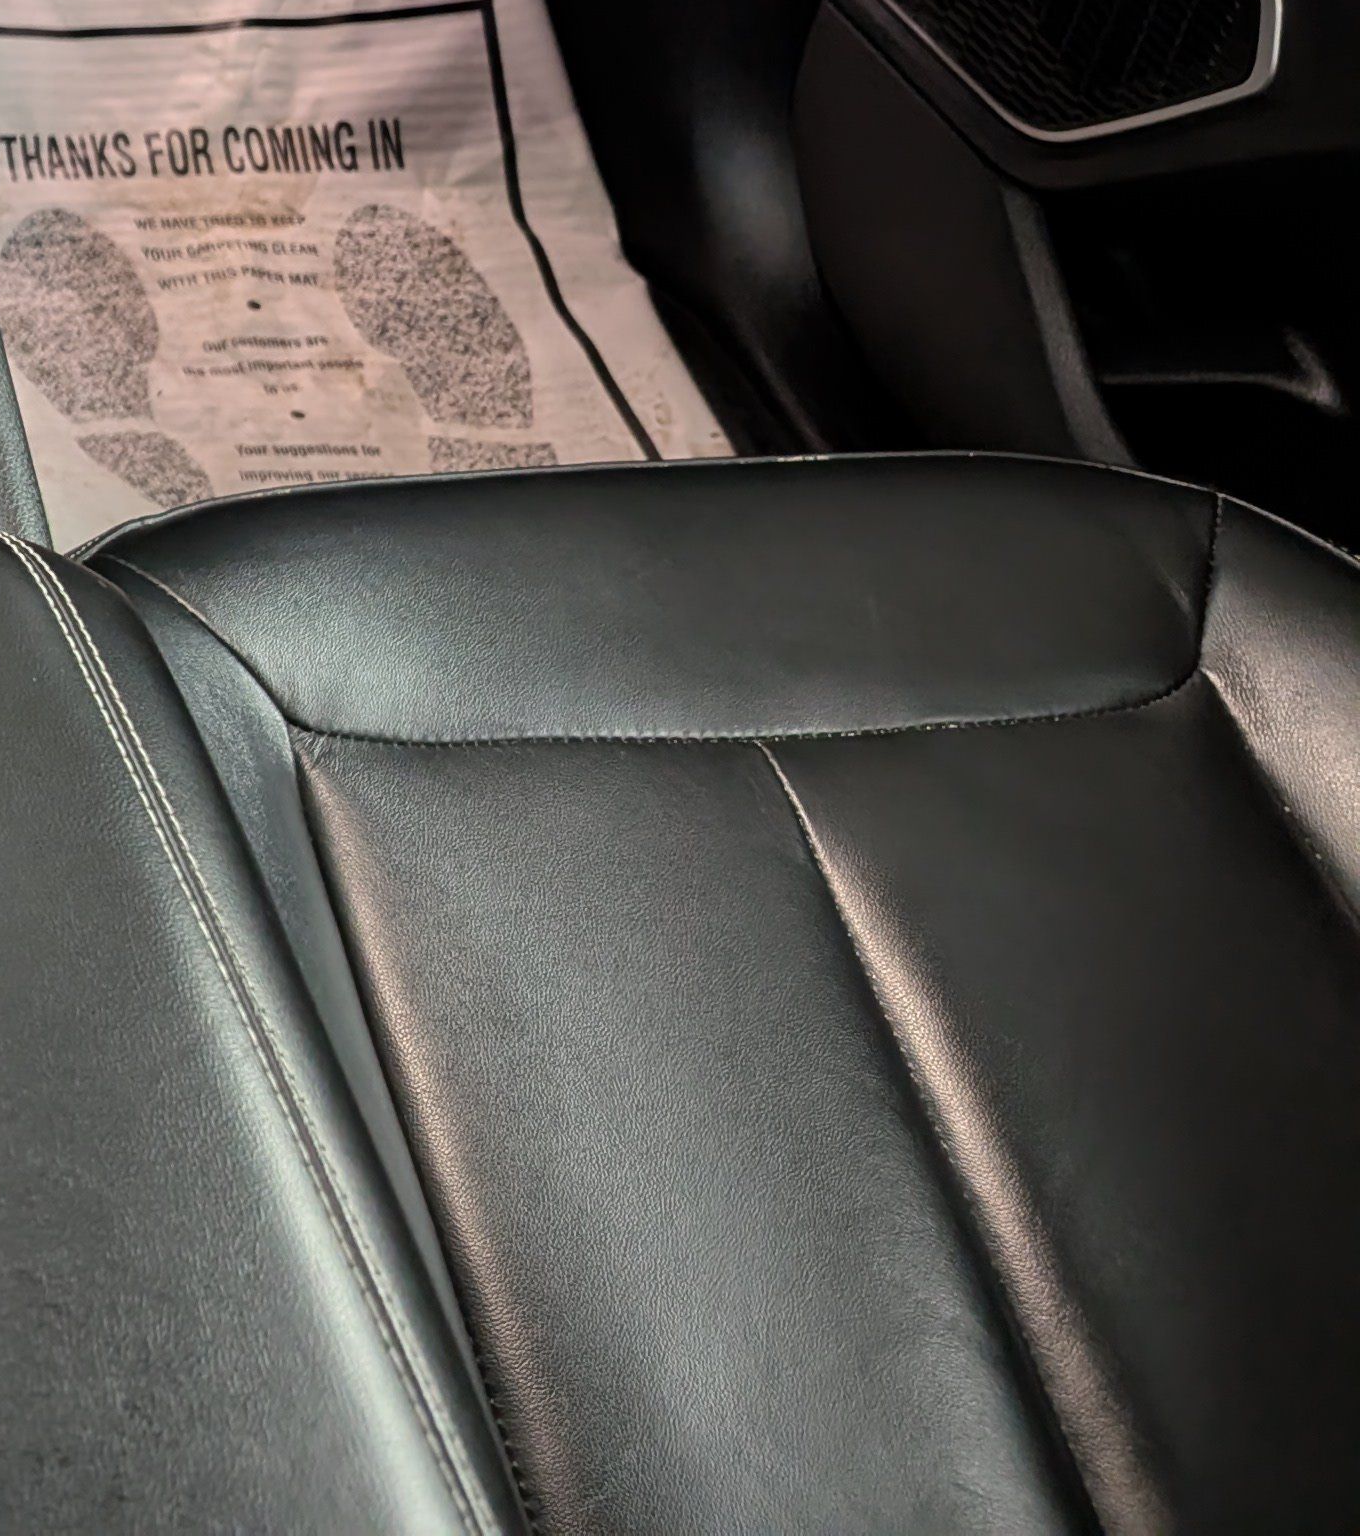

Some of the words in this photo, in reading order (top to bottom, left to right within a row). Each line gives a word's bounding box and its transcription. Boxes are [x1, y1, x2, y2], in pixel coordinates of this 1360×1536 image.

[143, 125, 215, 178] FOR
[222, 120, 360, 175] COMING
[367, 117, 407, 171] IN
[133, 217, 157, 230] WE
[160, 216, 197, 230] HAVE
[141, 246, 183, 261] YOUR
[272, 241, 319, 257] CLEAN
[156, 273, 198, 291] WITH
[203, 267, 237, 284] THIS
[288, 271, 319, 286] MAT
[235, 443, 268, 457] Your
[272, 443, 358, 457] suggestions
[361, 444, 382, 457] for
[238, 469, 313, 483] improving
